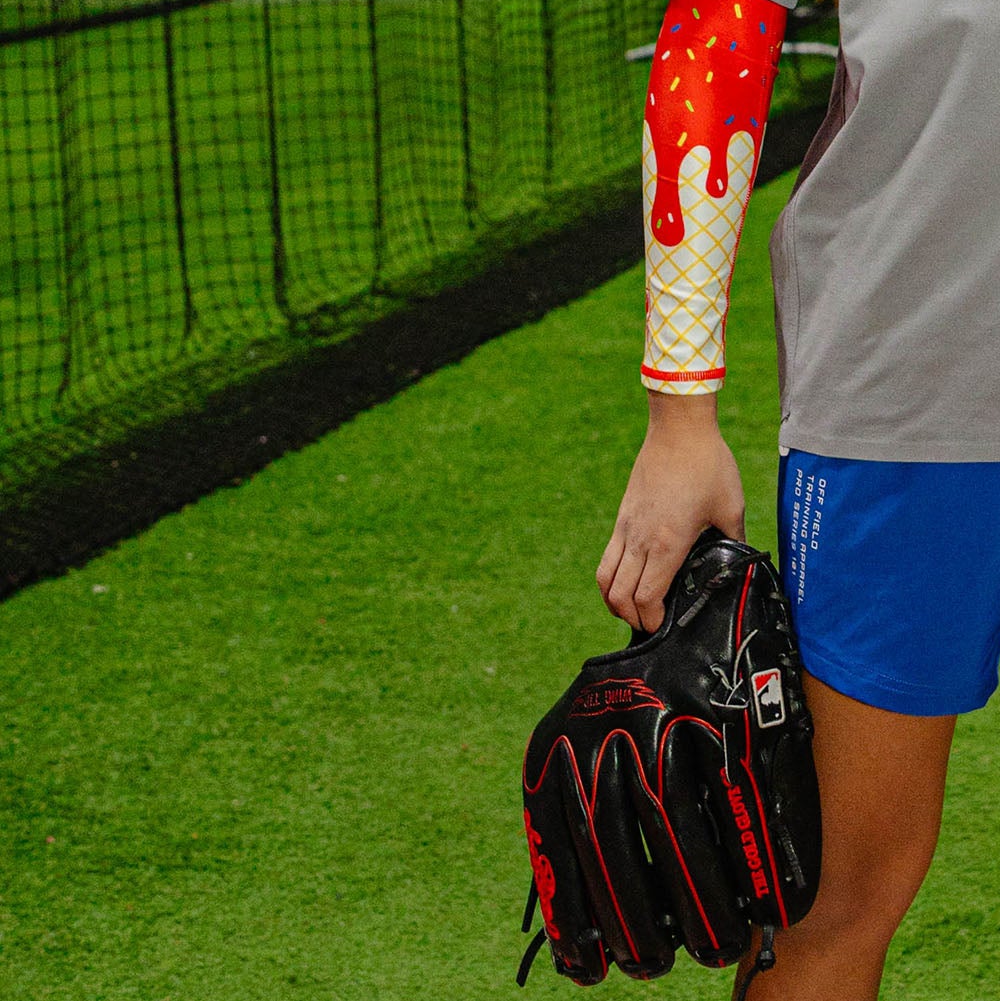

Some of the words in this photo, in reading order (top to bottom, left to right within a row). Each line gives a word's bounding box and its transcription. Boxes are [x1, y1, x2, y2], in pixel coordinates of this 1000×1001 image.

[794, 468, 803, 497] PRO
[816, 478, 827, 506] OFF
[791, 501, 800, 551] SERIES
[800, 474, 815, 539] TRAINING
[810, 509, 822, 550] FIELD
[797, 543, 807, 605] APPAREL
[727, 785, 751, 831] GLOVE
[740, 830, 762, 870] GOLD
[751, 868, 769, 899] THE
